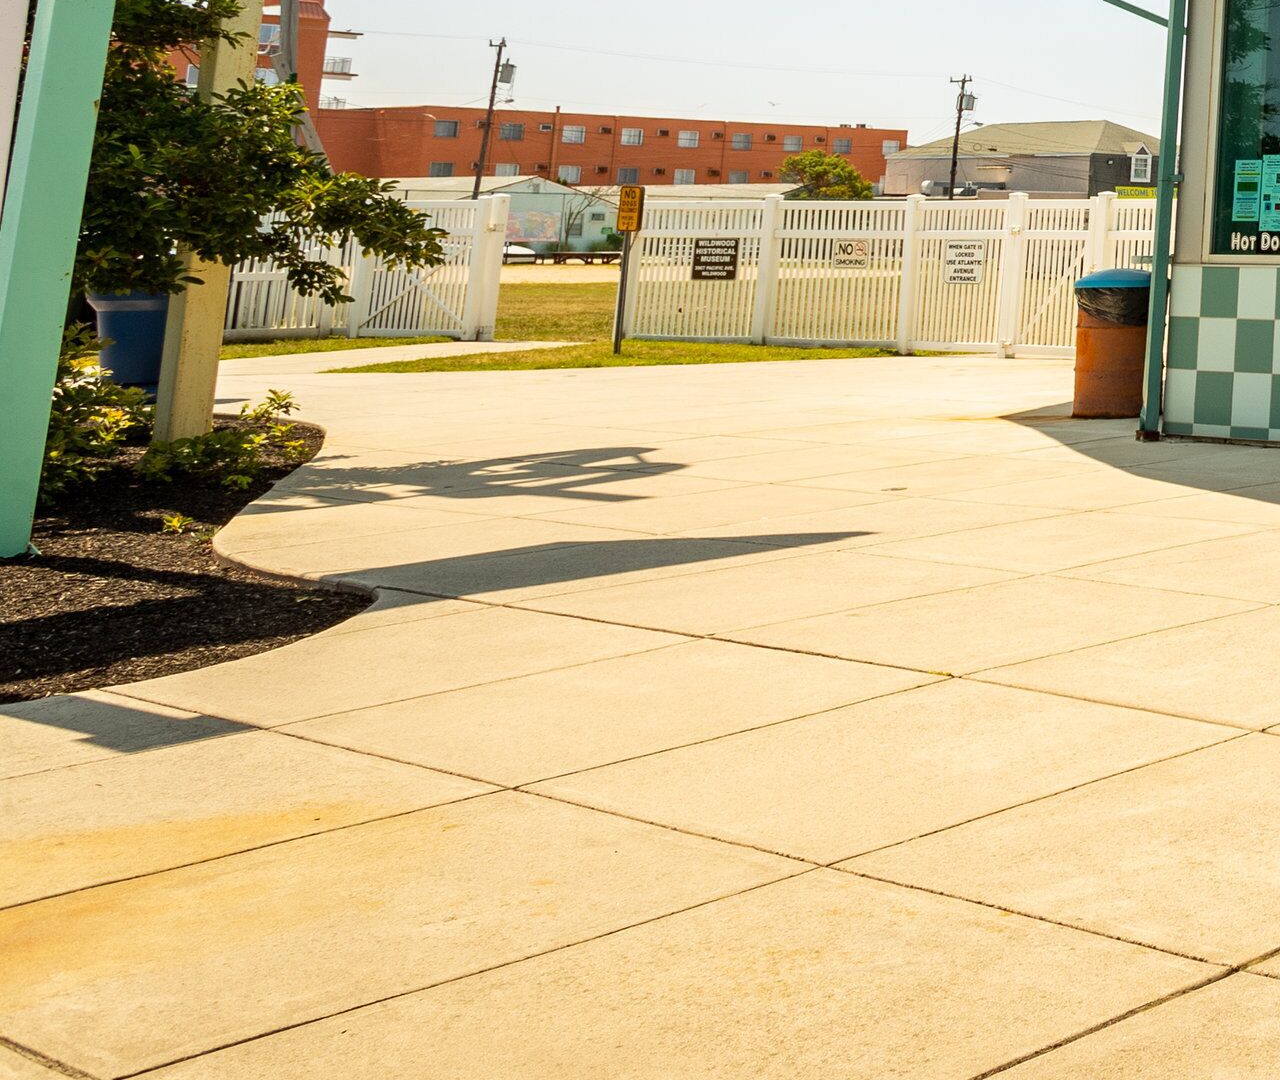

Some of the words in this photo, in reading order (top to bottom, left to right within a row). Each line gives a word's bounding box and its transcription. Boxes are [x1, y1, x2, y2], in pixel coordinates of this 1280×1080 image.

[624, 190, 637, 200] NO
[1118, 188, 1149, 197] WELCOME
[1230, 231, 1257, 251] HOT
[838, 243, 854, 256] NO
[835, 258, 866, 266] SMOKING
